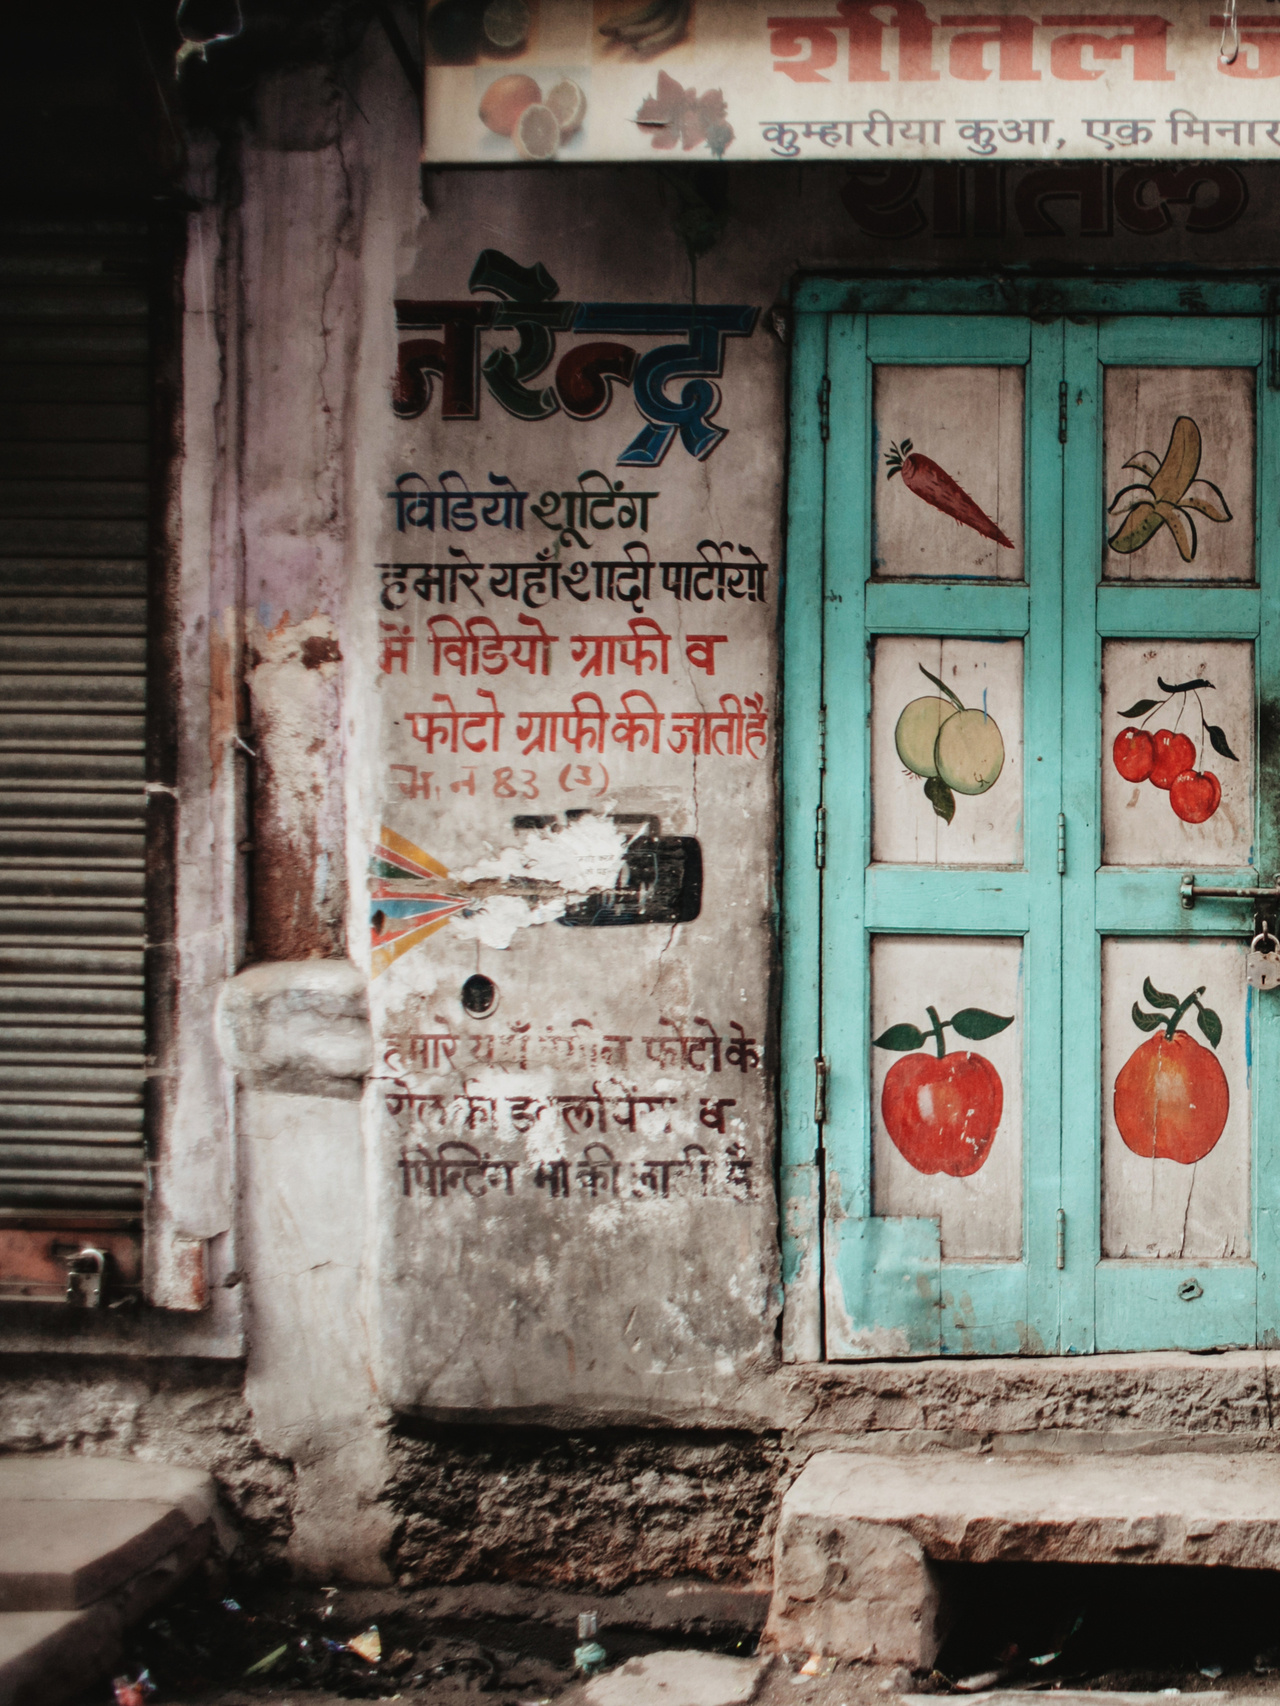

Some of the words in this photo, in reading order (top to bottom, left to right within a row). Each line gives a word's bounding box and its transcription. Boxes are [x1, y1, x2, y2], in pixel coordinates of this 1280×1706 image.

[766, 0, 1176, 84] शीतल
[1082, 118, 1155, 153] एक
[386, 470, 530, 533] विडियो
[529, 470, 661, 549] शूटिंग
[374, 546, 485, 611] हमारे
[490, 547, 562, 609] यहाँ
[561, 541, 656, 613] शादी
[427, 612, 559, 676] विडियो
[570, 617, 672, 678] ग्राफी
[686, 634, 729, 676] व
[404, 688, 505, 754] फोटो
[516, 691, 610, 756] ग्राफी
[611, 689, 665, 754] की
[667, 693, 744, 756] जाती
[744, 691, 769, 760] है
[725, 1020, 760, 1073] के
